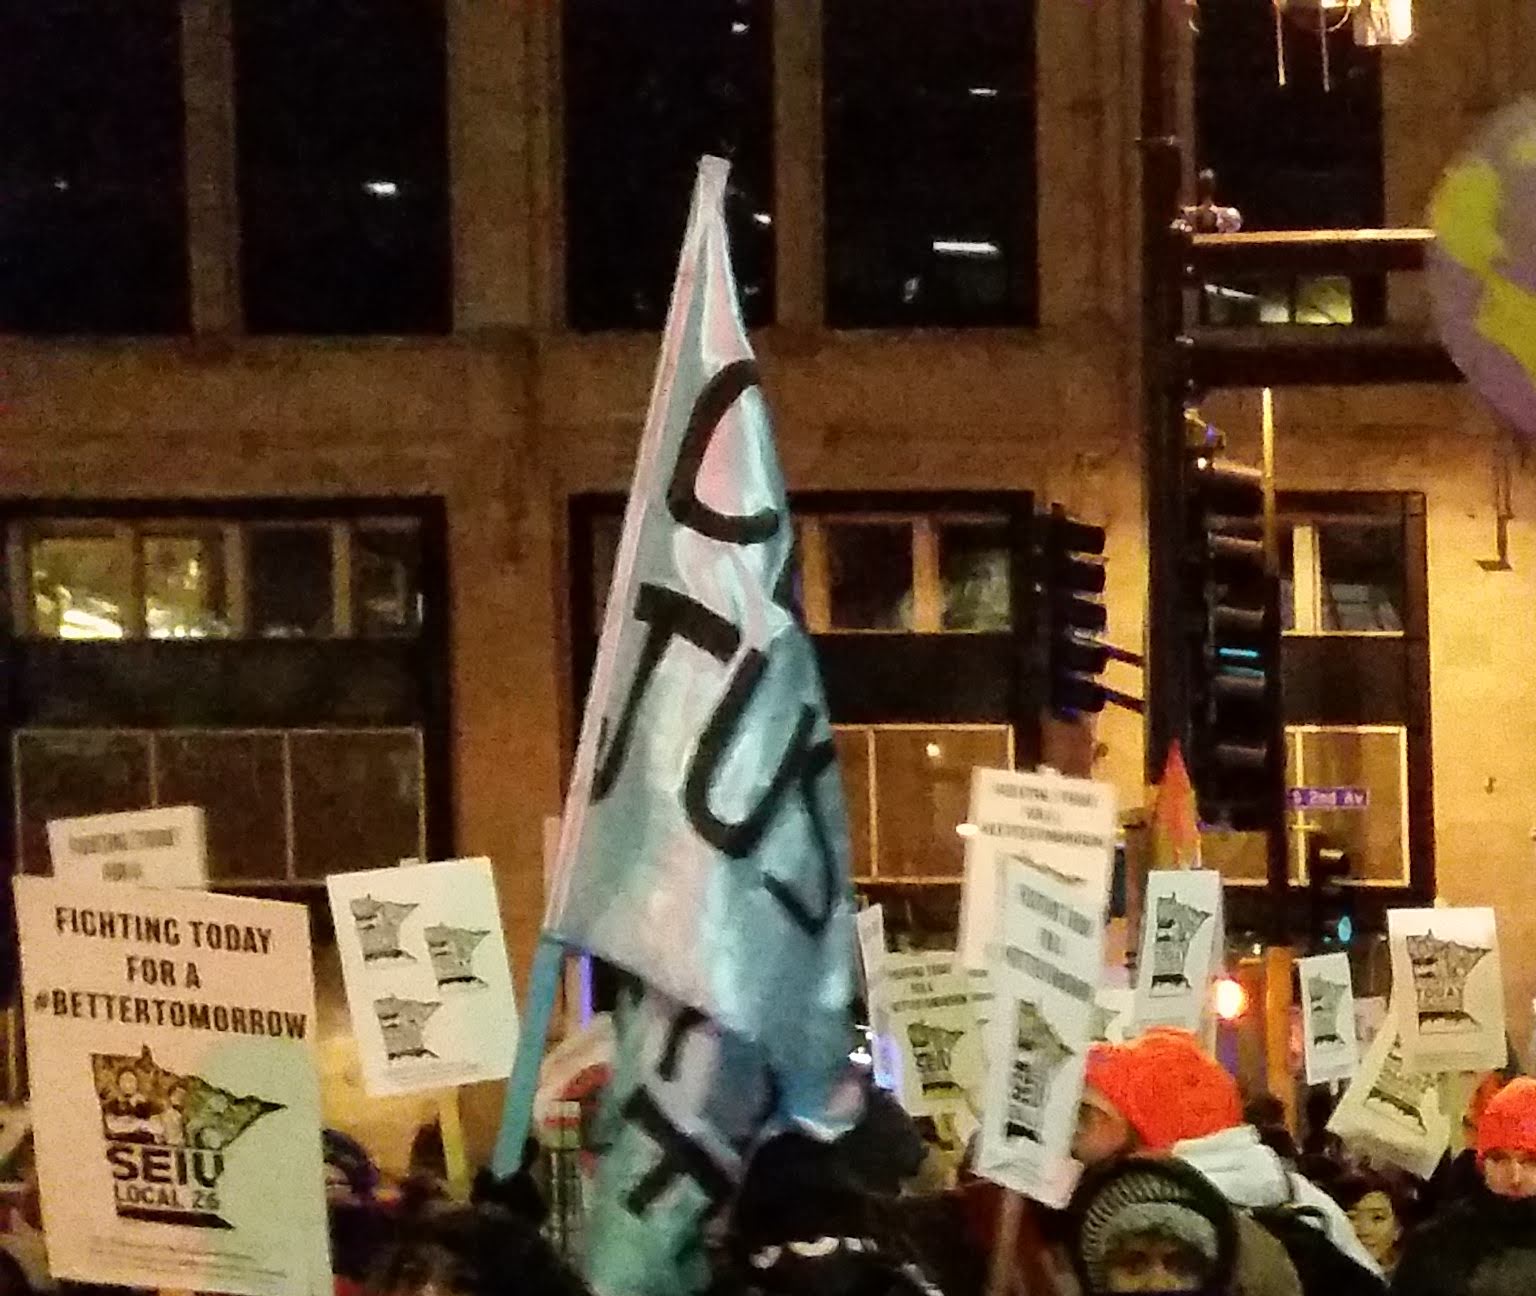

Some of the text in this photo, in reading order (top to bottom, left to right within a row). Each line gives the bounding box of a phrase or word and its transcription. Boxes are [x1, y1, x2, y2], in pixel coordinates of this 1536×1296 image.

[55, 906, 272, 955] FIGHTING TODAY
[126, 954, 202, 990] FOR A
[34, 987, 307, 1041] #BETTERTOMORROW
[106, 1144, 225, 1188] SEIU
[114, 1181, 221, 1211] LOCAL 26
